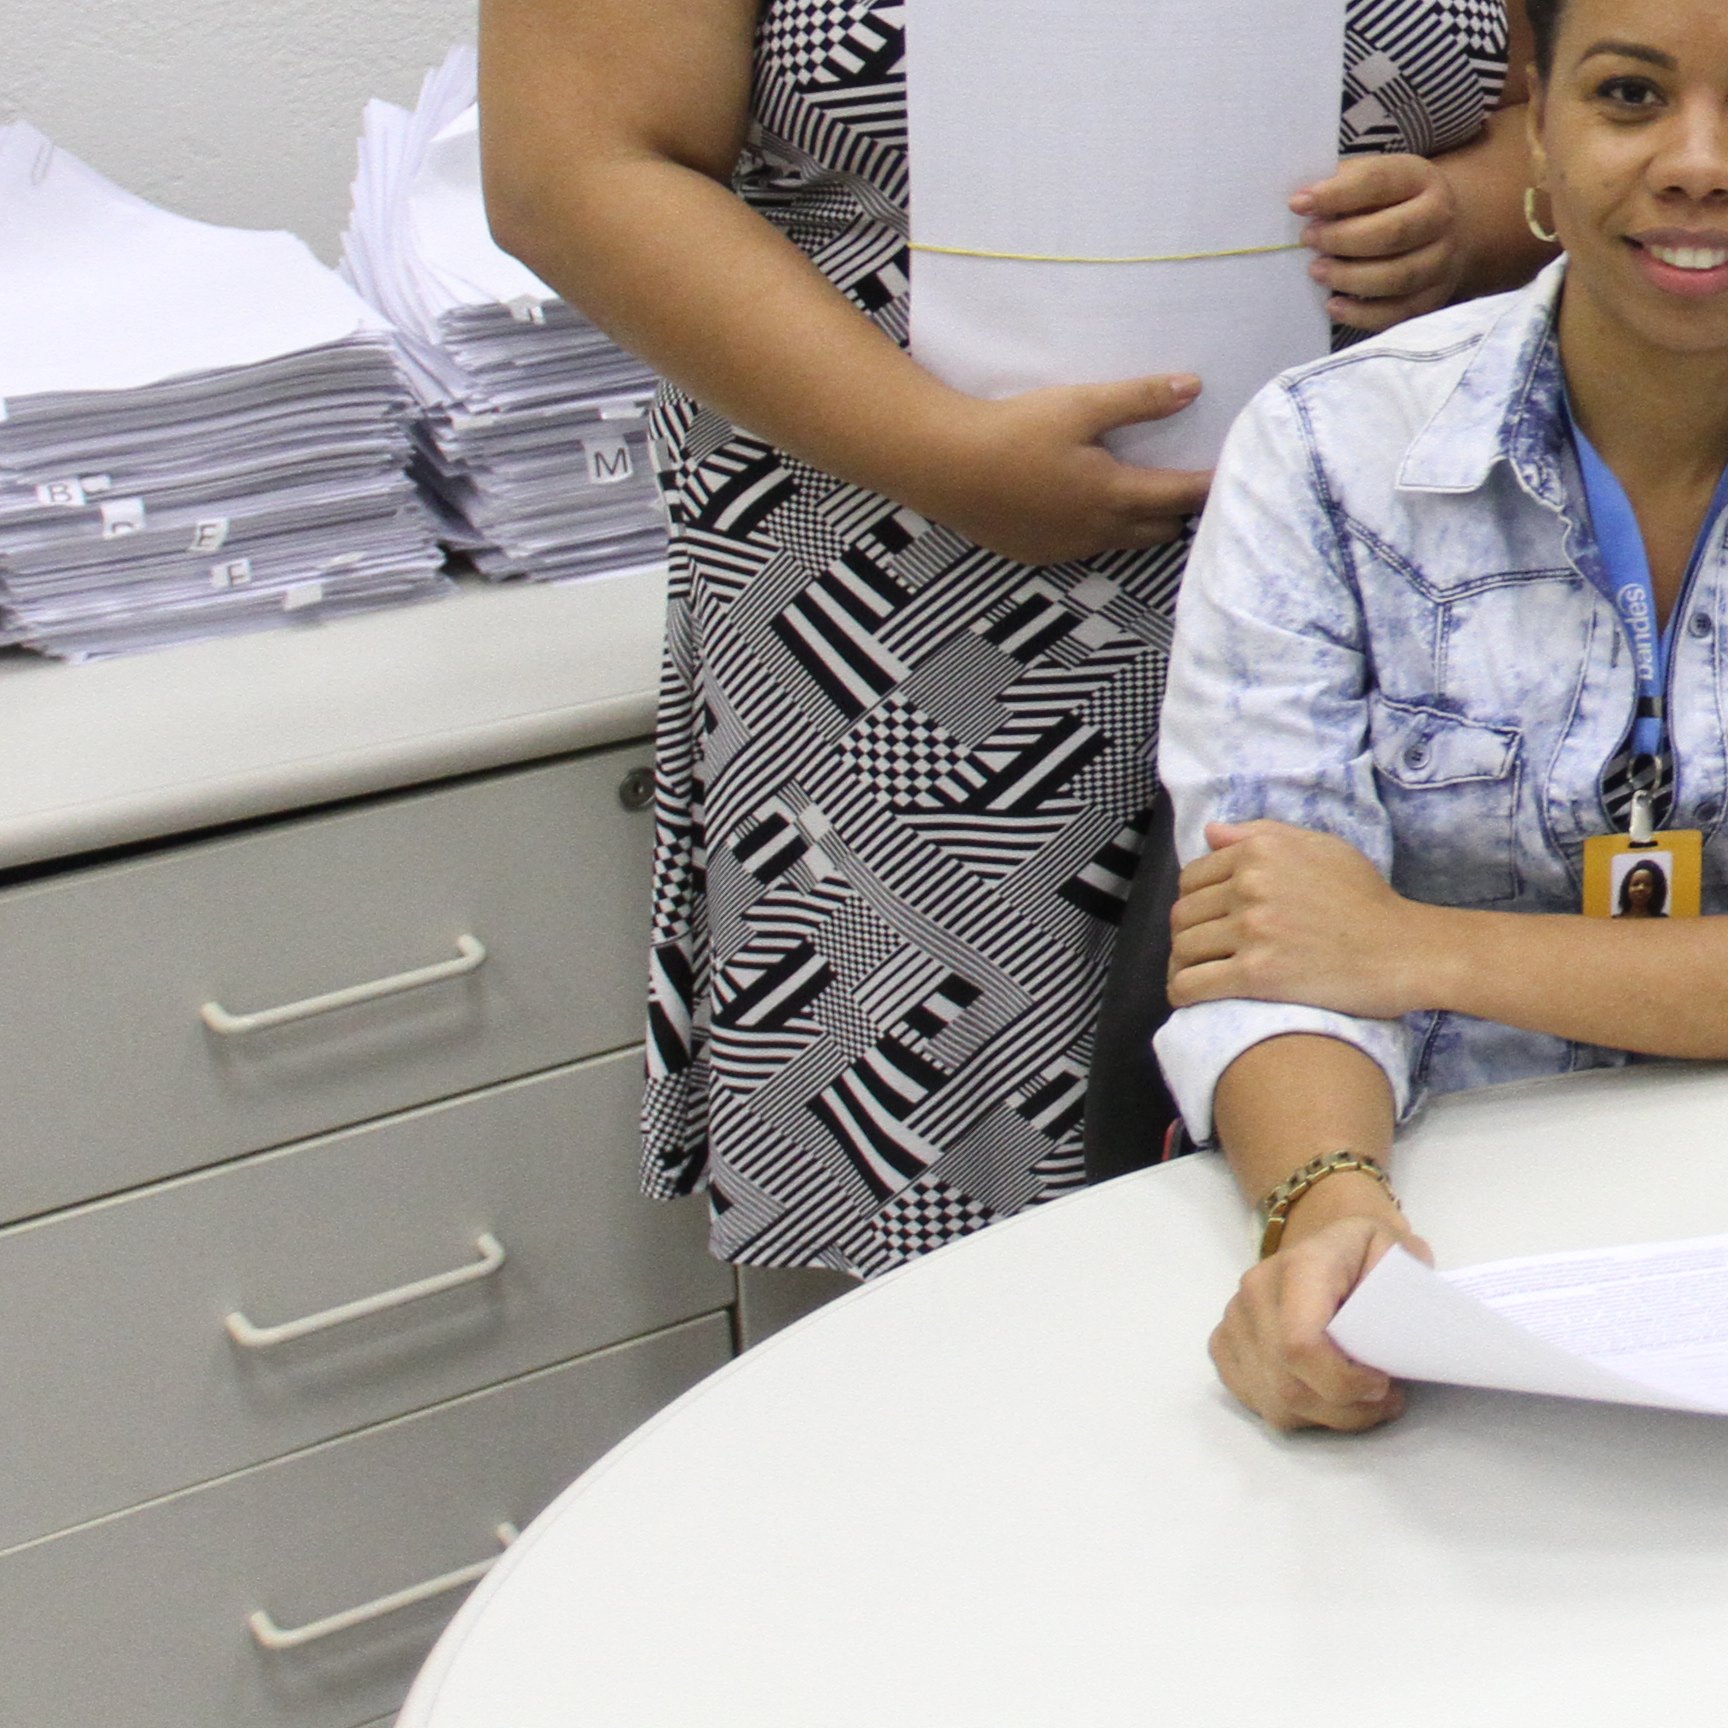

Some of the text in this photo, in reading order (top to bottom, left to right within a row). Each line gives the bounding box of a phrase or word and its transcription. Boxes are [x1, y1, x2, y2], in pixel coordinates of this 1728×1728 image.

[595, 448, 627, 477] M
[48, 484, 72, 504] B
[1617, 583, 1654, 680] bandes
